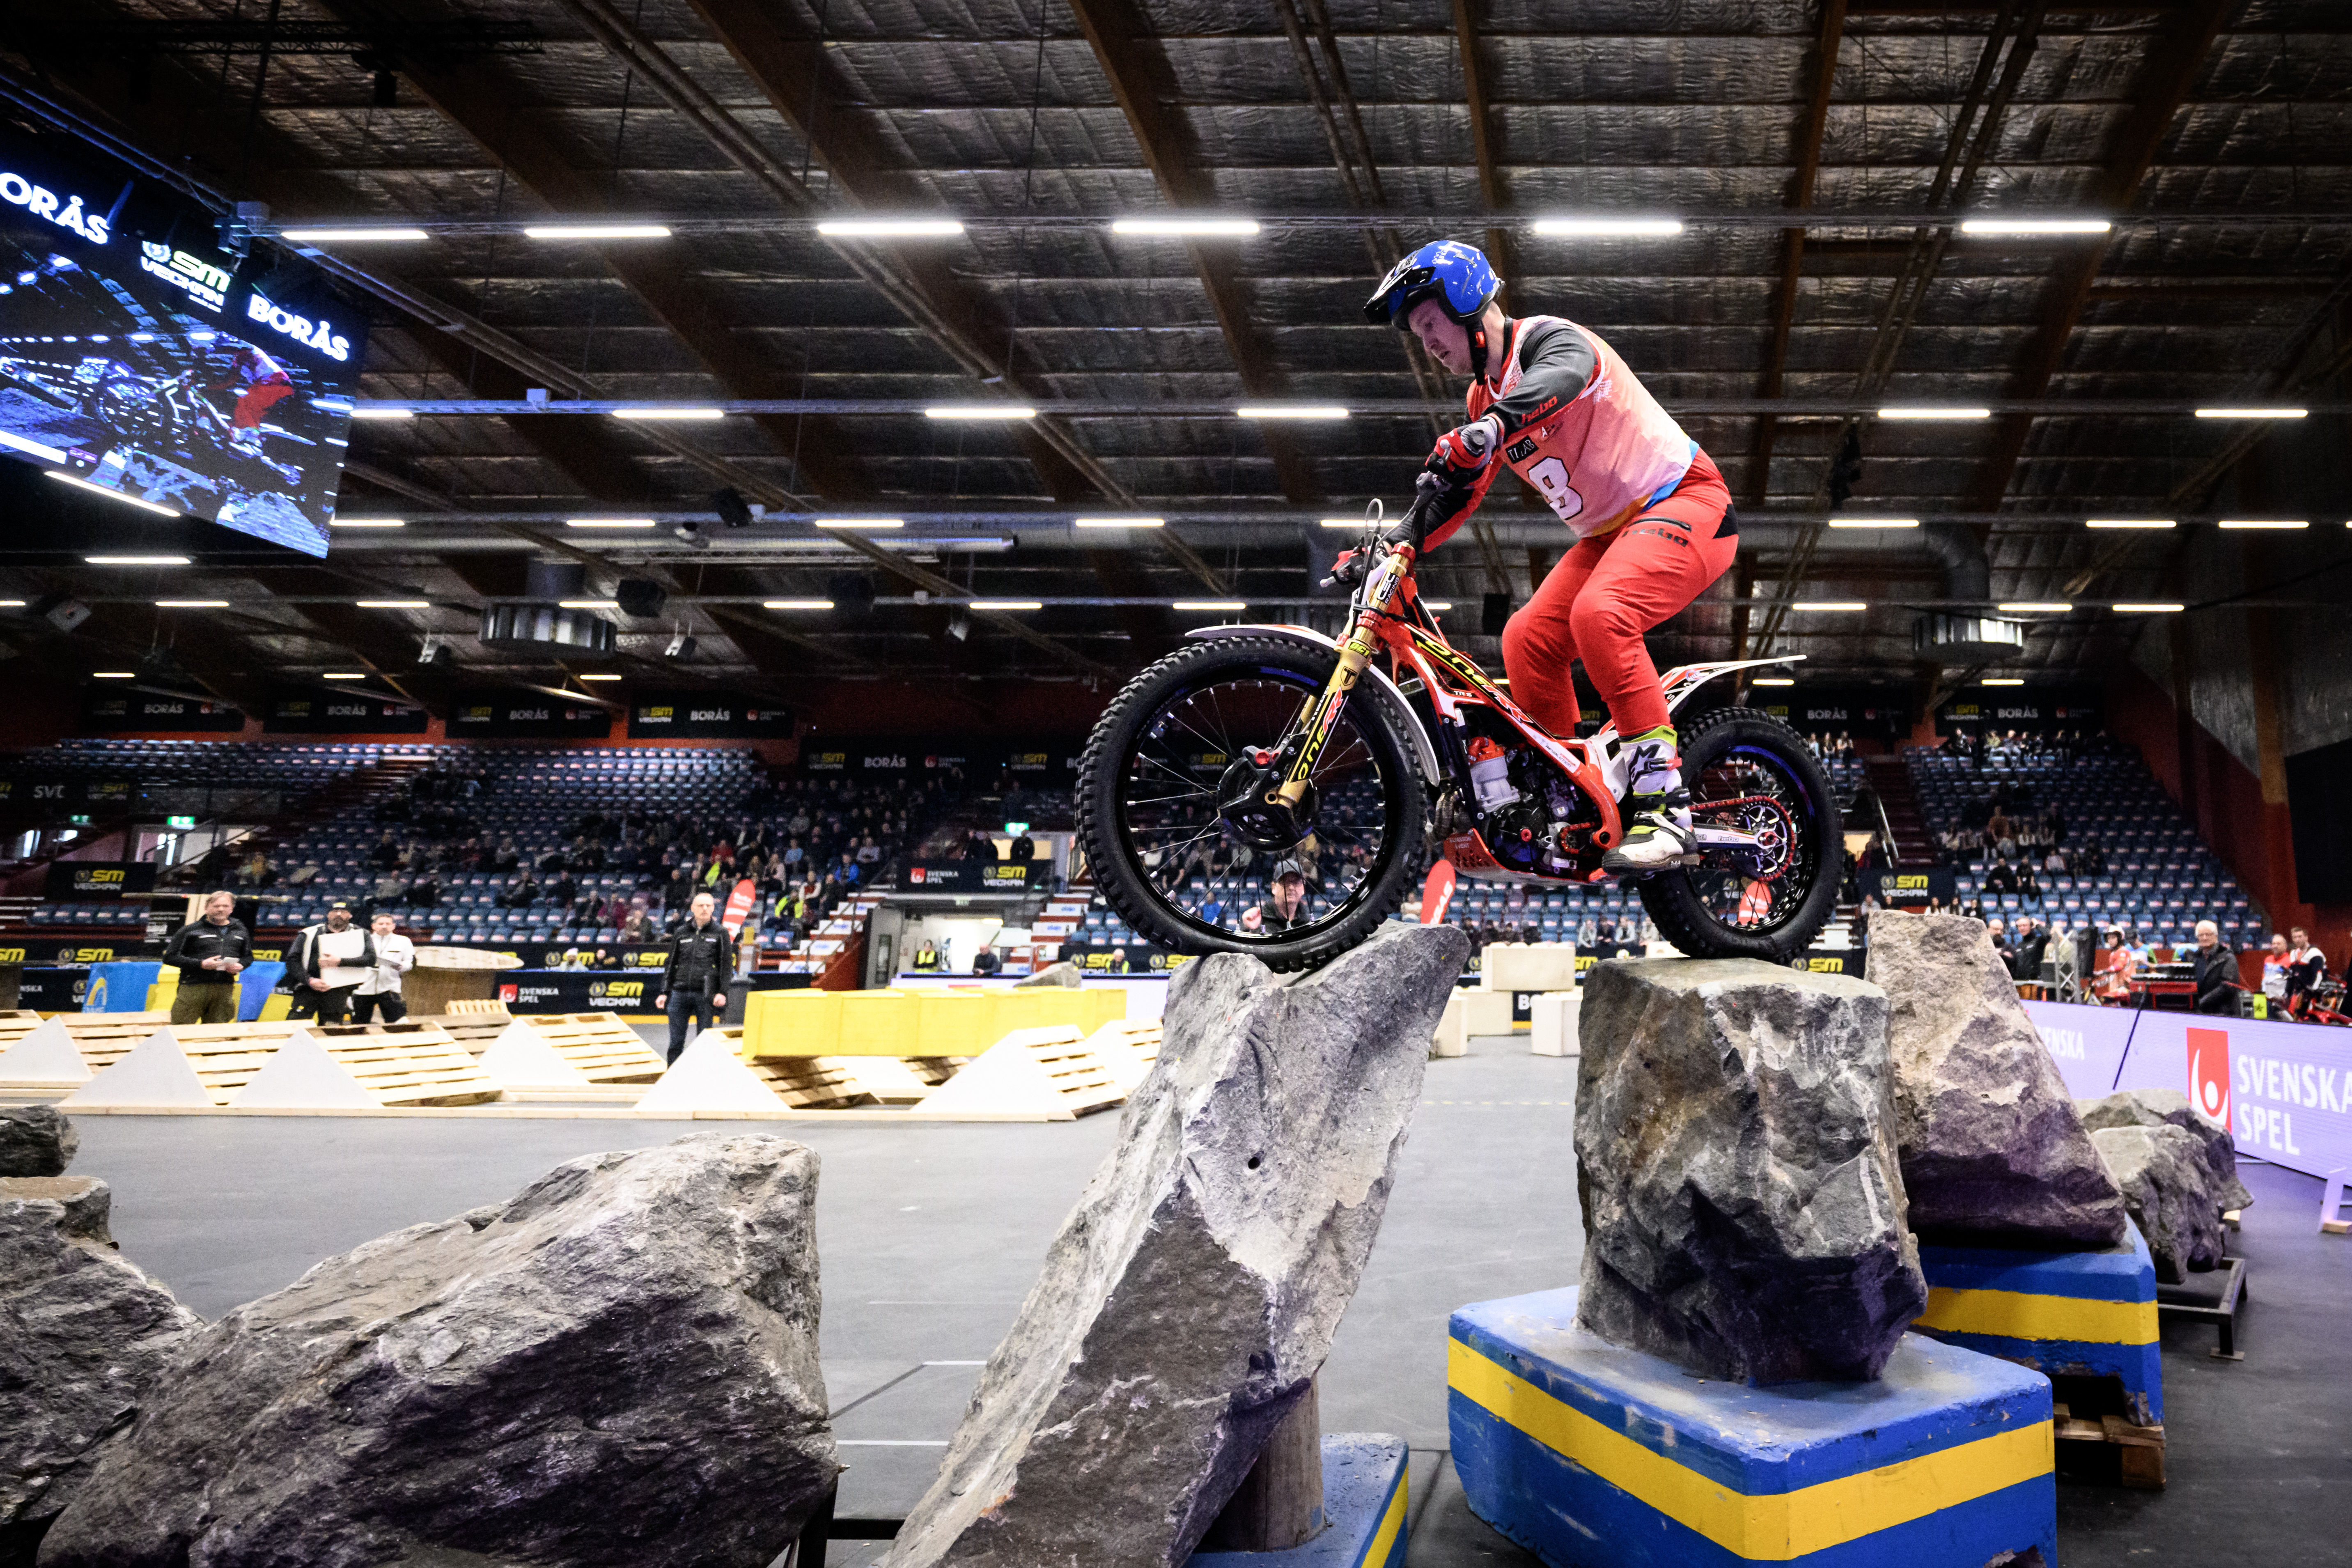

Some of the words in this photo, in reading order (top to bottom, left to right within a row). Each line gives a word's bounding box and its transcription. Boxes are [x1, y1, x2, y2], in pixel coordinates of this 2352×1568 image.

[170, 250, 231, 292] SM
[140, 256, 225, 306] VECKAN
[248, 294, 350, 361] BORÅS
[1521, 396, 1558, 424] hebo
[1385, 577, 1400, 604] RACING
[509, 707, 549, 721] BORÅS
[690, 707, 730, 721] BORÅS
[1807, 706, 1847, 720] BORÅS
[1997, 705, 2039, 719] BORÅS
[864, 753, 907, 768] BORÅS
[91, 869, 125, 882] SM
[997, 866, 1026, 879] SM
[1896, 875, 1928, 888] SM
[75, 948, 113, 962] SM
[1808, 957, 1843, 973] SM
[519, 987, 559, 995] SVENSKA
[606, 982, 644, 996] SM
[589, 998, 640, 1006] VECKAN
[2237, 1054, 2352, 1114] SVENSKA
[2239, 1102, 2300, 1156] SPEL
